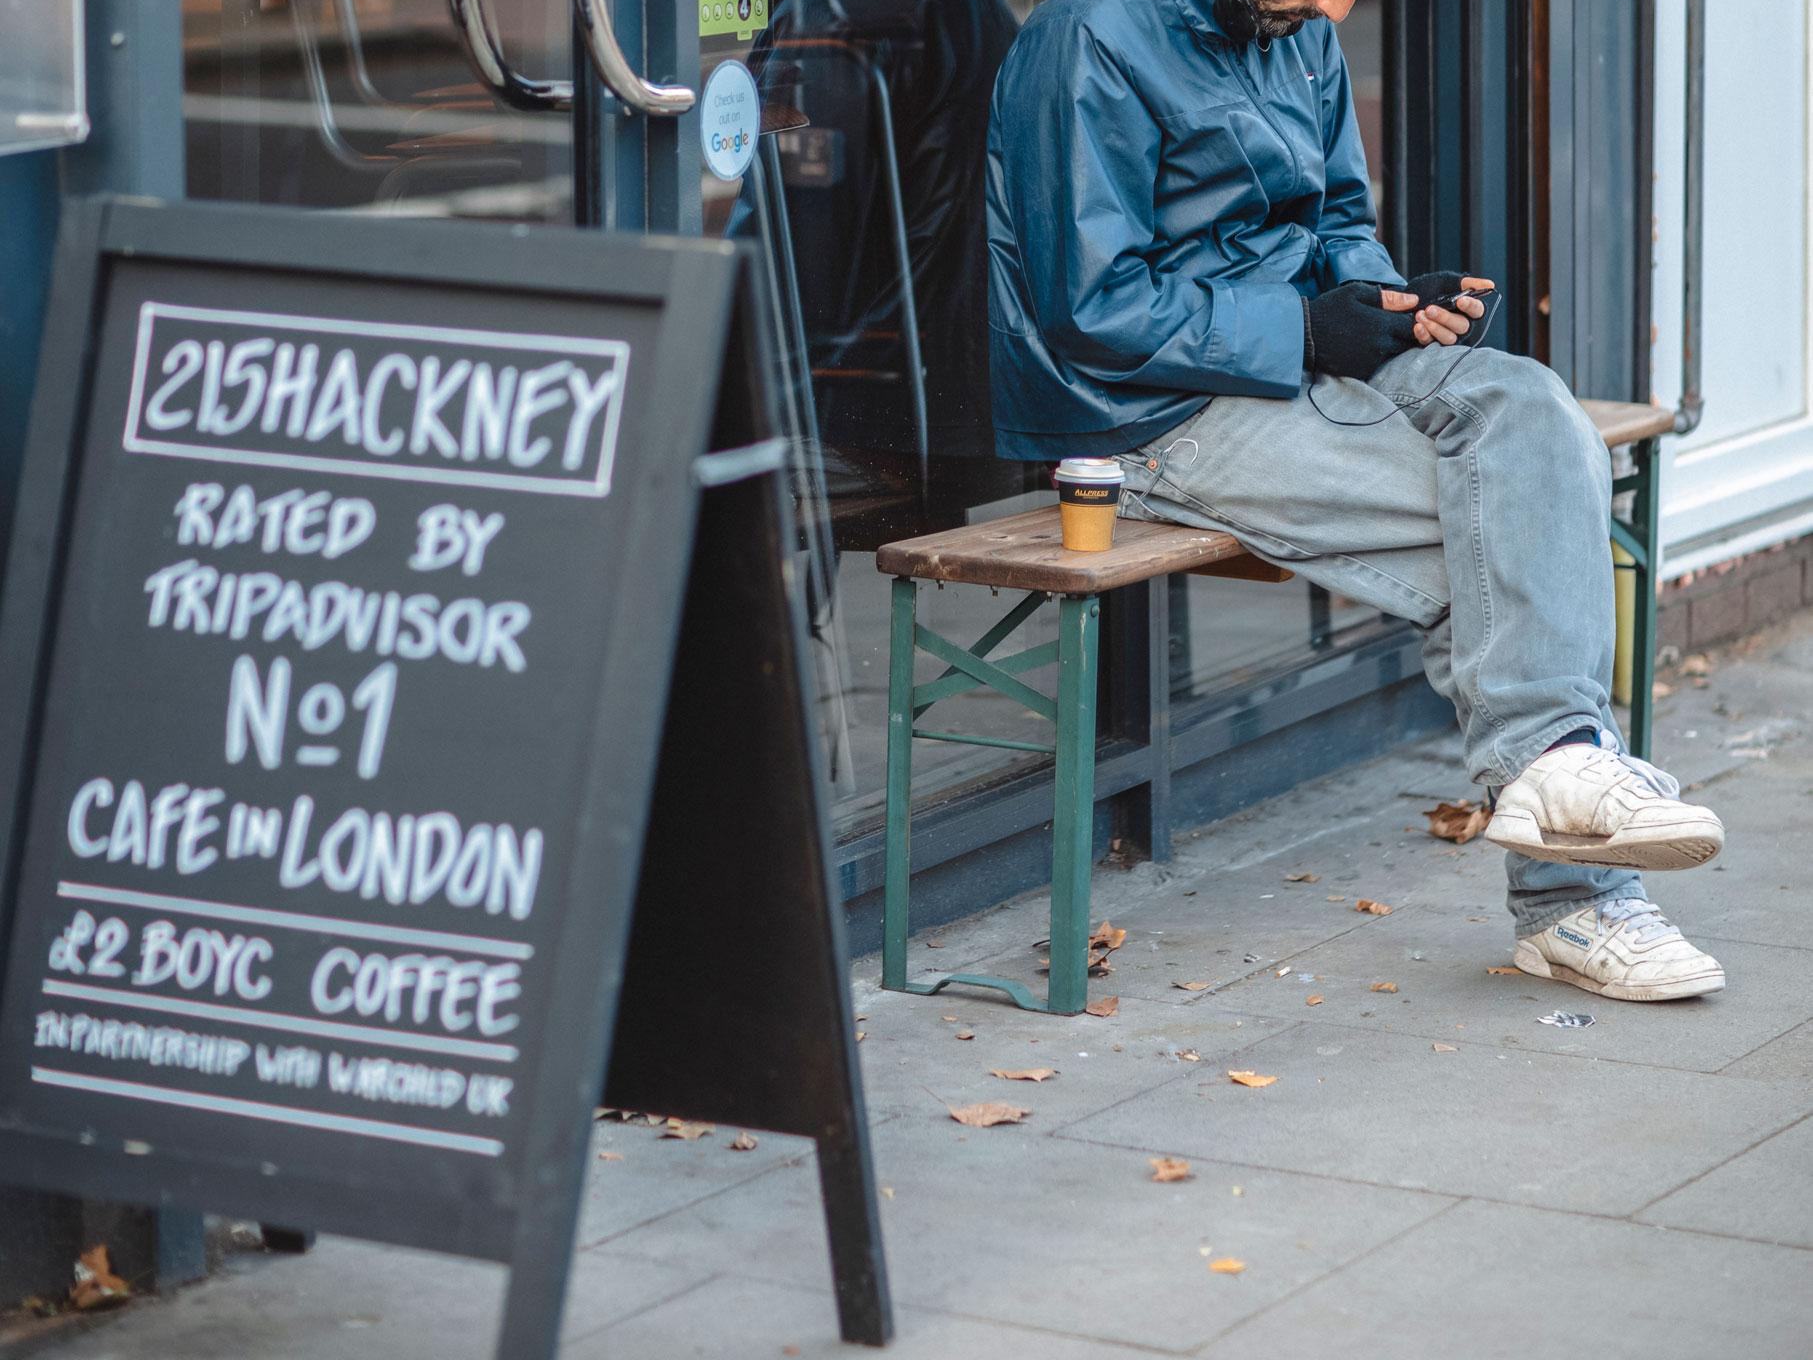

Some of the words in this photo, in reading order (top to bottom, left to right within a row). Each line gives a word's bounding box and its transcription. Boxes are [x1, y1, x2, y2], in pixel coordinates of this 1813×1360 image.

[711, 127, 749, 153] Google
[174, 481, 377, 558] RATED
[408, 504, 506, 577] BY
[143, 558, 531, 674] TRIPADVISOR
[67, 777, 226, 876] CAFE
[279, 794, 545, 921] LONDON
[131, 919, 274, 1001] BOYC
[310, 946, 522, 1037] COFFEE
[1557, 926, 1590, 947] Reebok
[69, 1013, 252, 1077] PARTNERSHIP
[255, 1043, 322, 1088] WITH
[465, 1072, 515, 1117] UK
